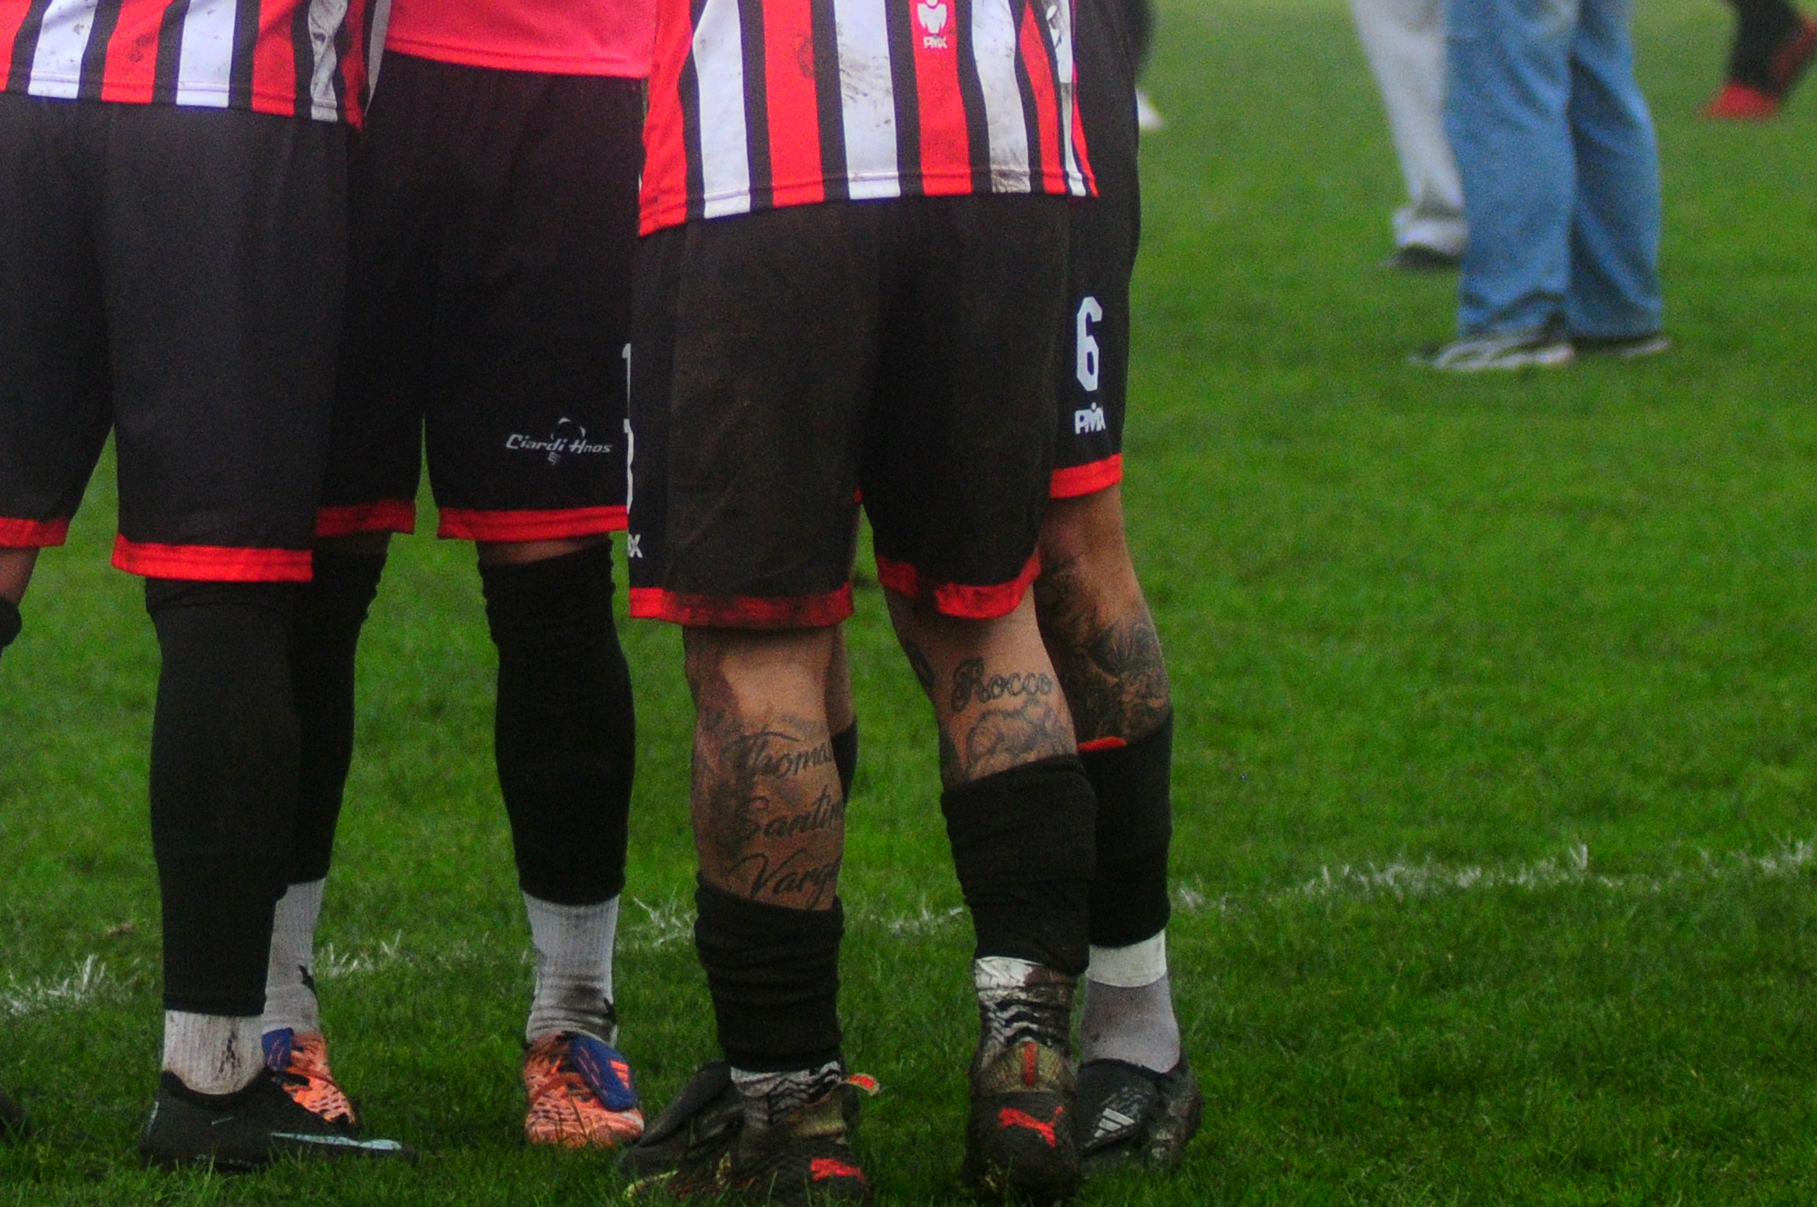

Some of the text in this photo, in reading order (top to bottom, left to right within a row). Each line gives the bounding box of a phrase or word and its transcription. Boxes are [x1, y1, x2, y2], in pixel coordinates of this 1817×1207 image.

[1077, 296, 1103, 392] 6
[505, 433, 613, 454] Ciardi Hnos
